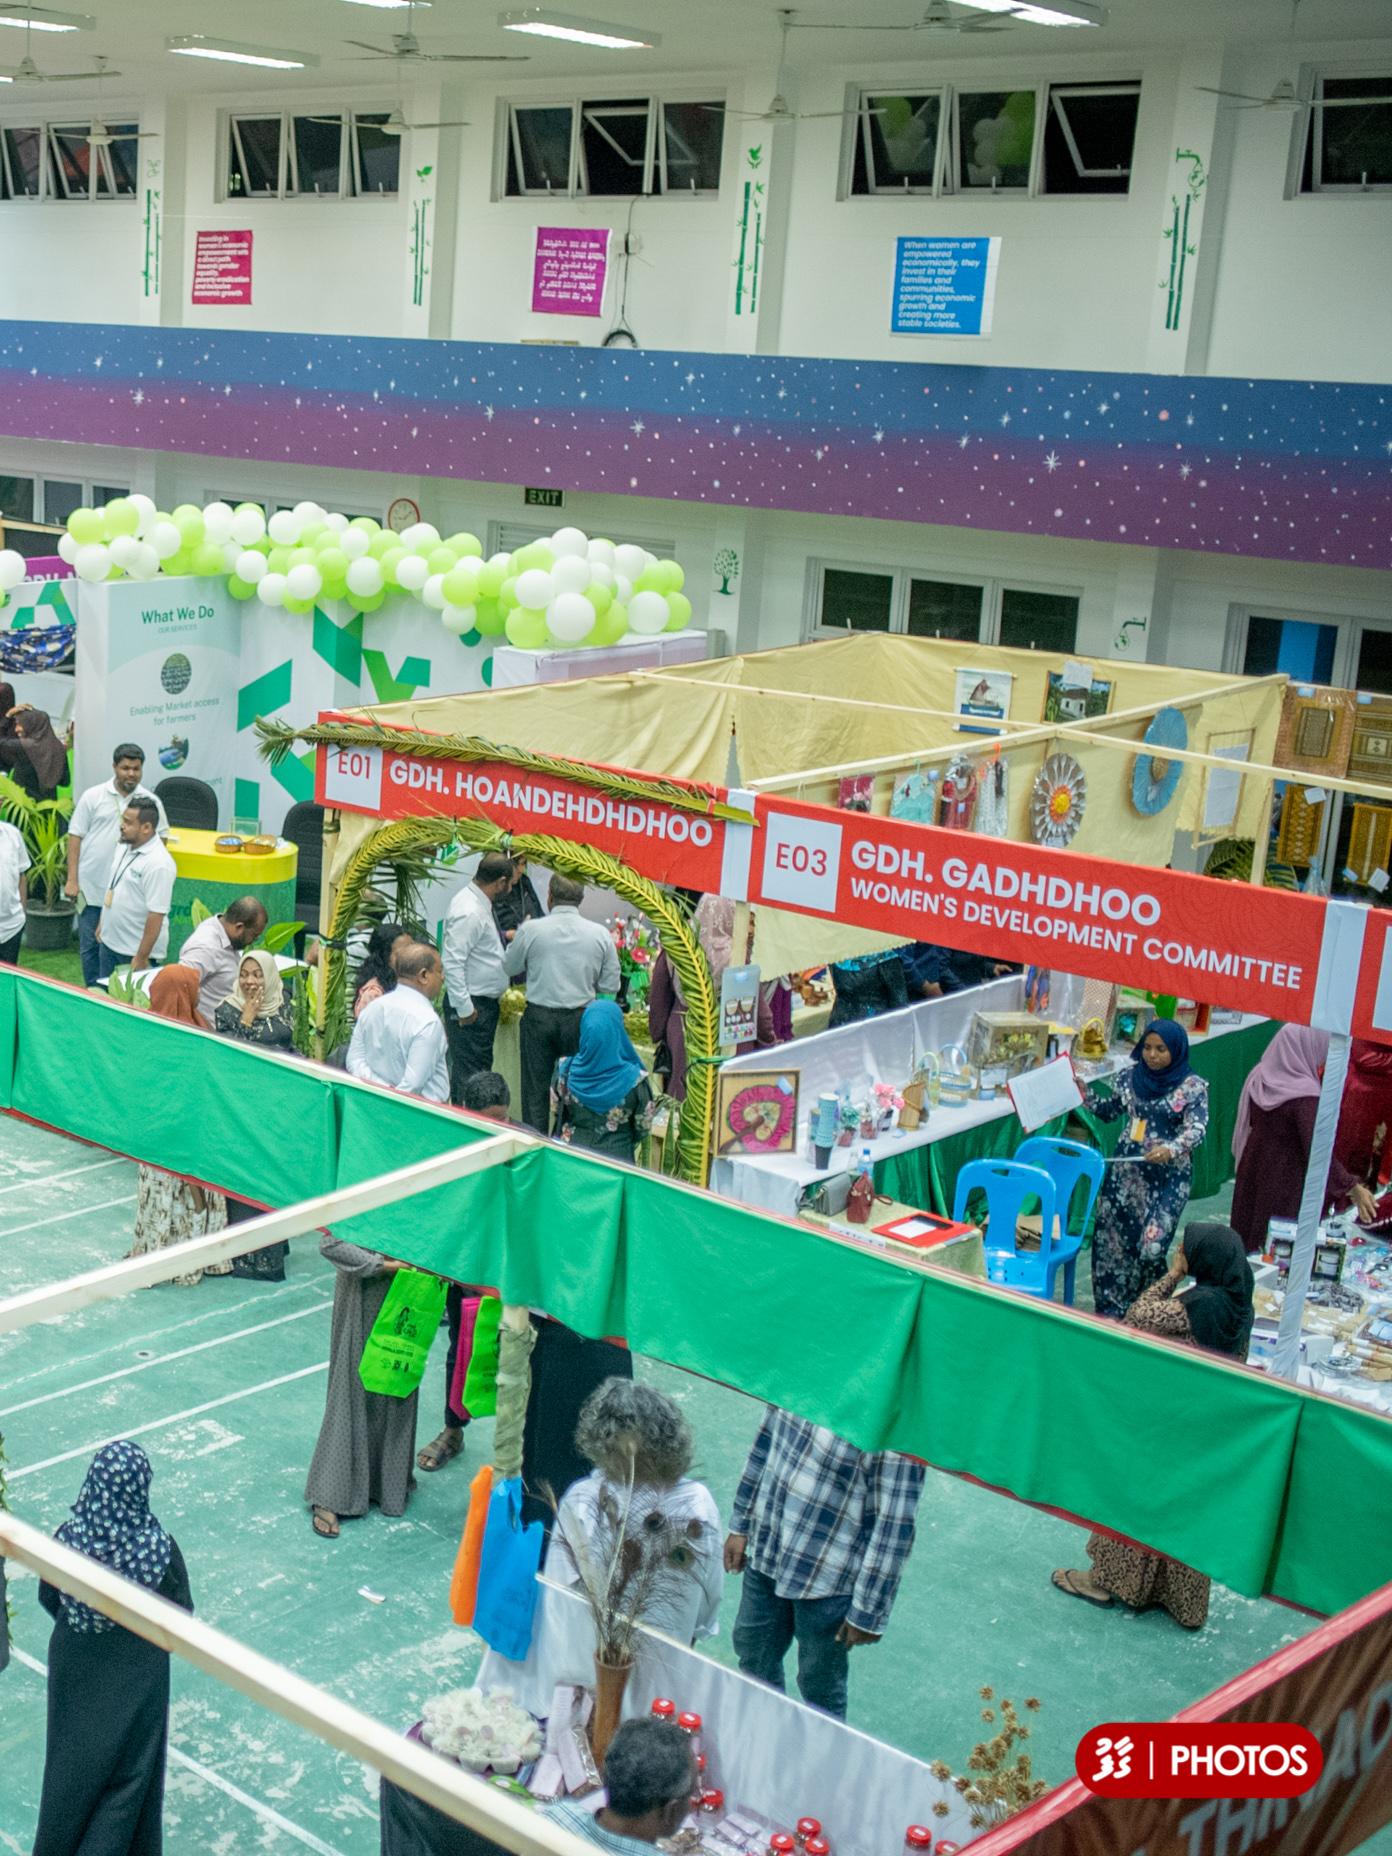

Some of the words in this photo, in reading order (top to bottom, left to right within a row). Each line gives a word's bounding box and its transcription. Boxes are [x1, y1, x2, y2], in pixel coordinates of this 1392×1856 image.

[529, 490, 559, 505] EXIT
[141, 609, 174, 624] What
[176, 607, 196, 622] We
[198, 605, 214, 618] Do
[130, 704, 164, 718] Enabling
[165, 700, 192, 715] Market
[194, 698, 220, 709] access
[153, 716, 165, 726] for
[166, 712, 196, 725] farmers
[338, 752, 371, 780] E01
[389, 760, 449, 796] GDH.
[455, 774, 712, 848] HOANDEHDHDHOO
[776, 842, 829, 877] E03
[851, 840, 934, 883] GDH.
[942, 858, 1162, 926] GADHDHOO
[850, 878, 958, 920] WOMEN'S
[963, 902, 1137, 952] DEVELOPMENT
[1143, 936, 1304, 991] COMMITTEE
